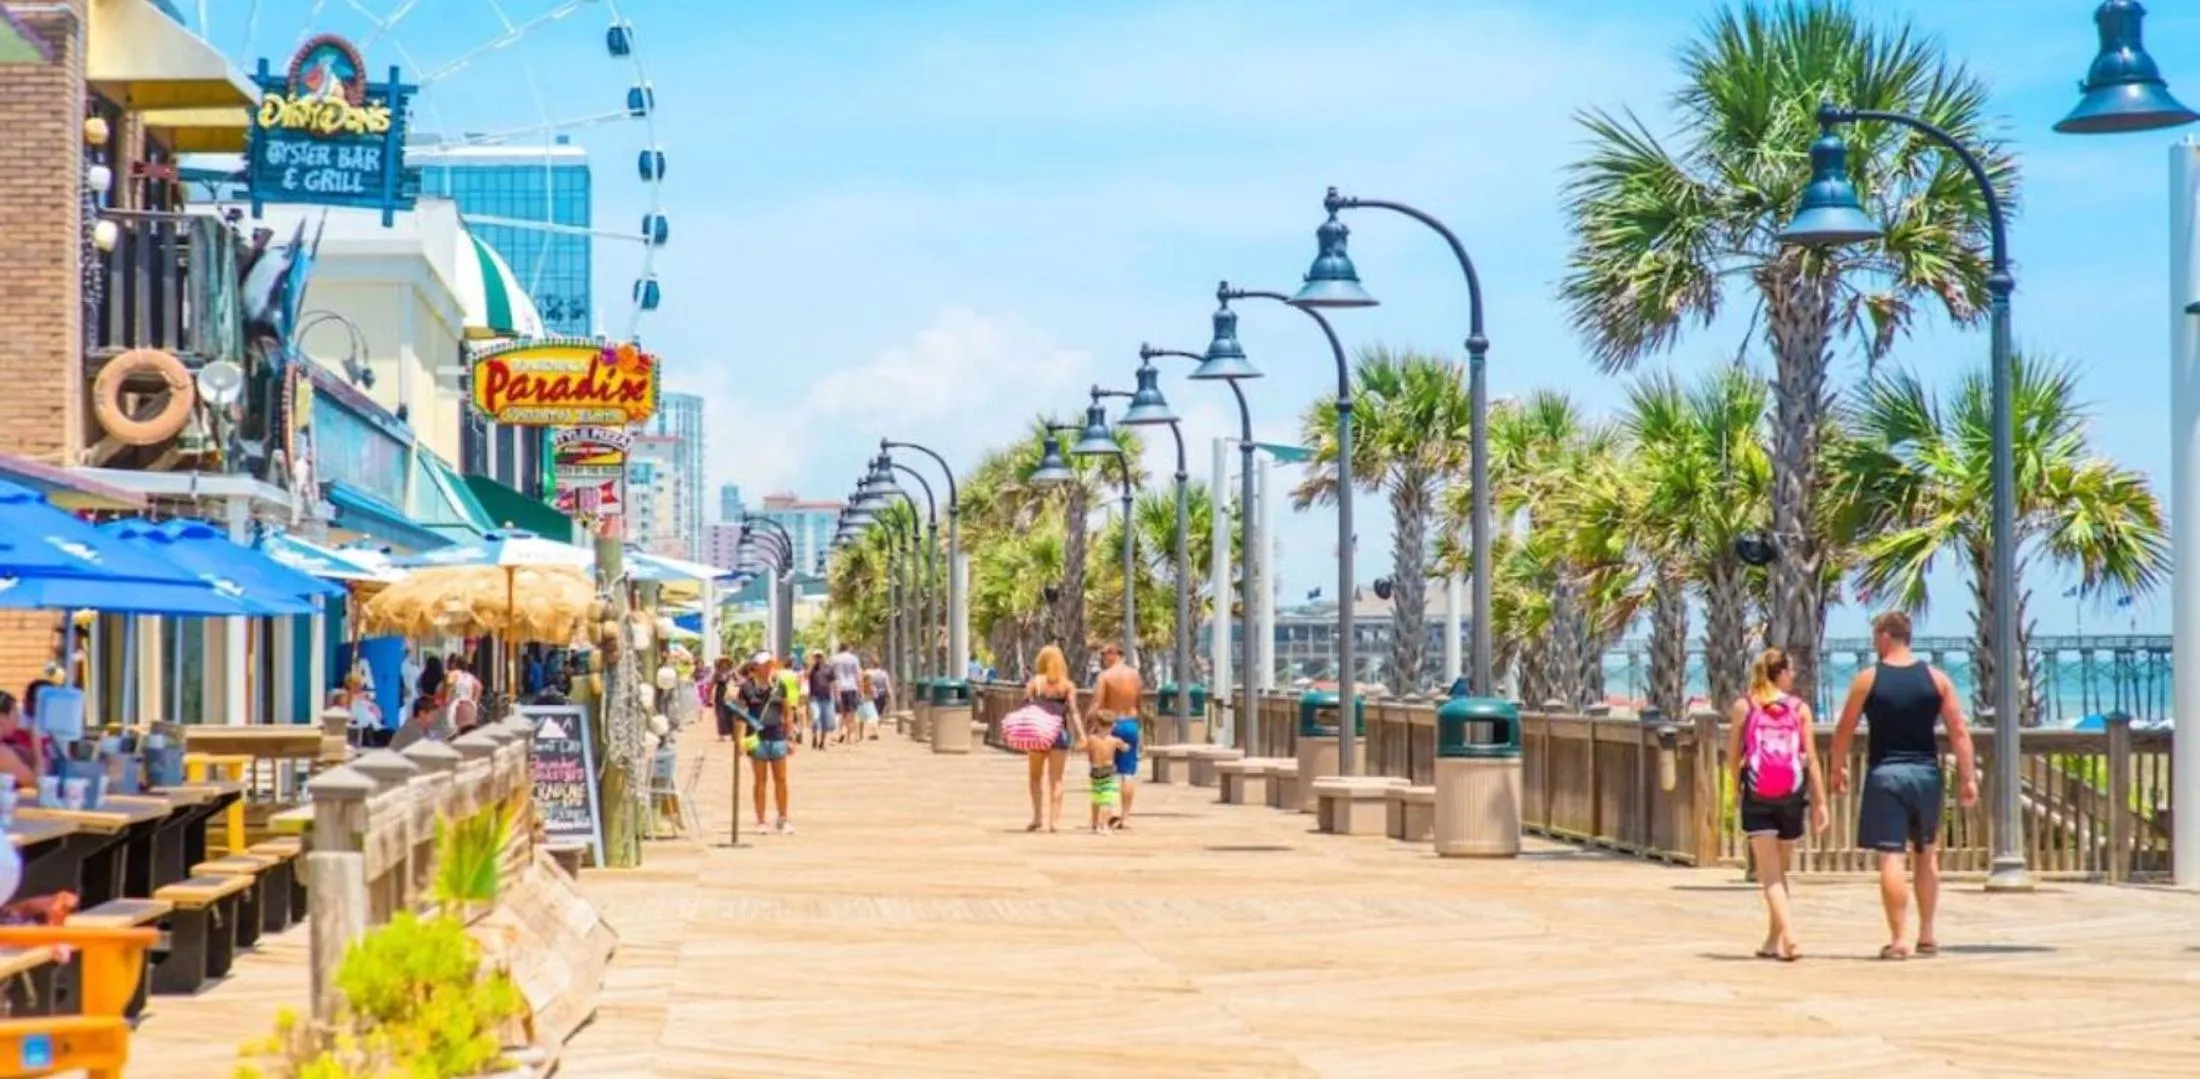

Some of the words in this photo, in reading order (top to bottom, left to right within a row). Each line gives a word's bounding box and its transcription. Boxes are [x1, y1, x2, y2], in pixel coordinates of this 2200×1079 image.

[266, 140, 331, 165] OYSTER
[337, 146, 381, 172] BAR
[281, 167, 299, 190] &
[304, 168, 365, 193] GRILL
[485, 353, 648, 414] Paradise
